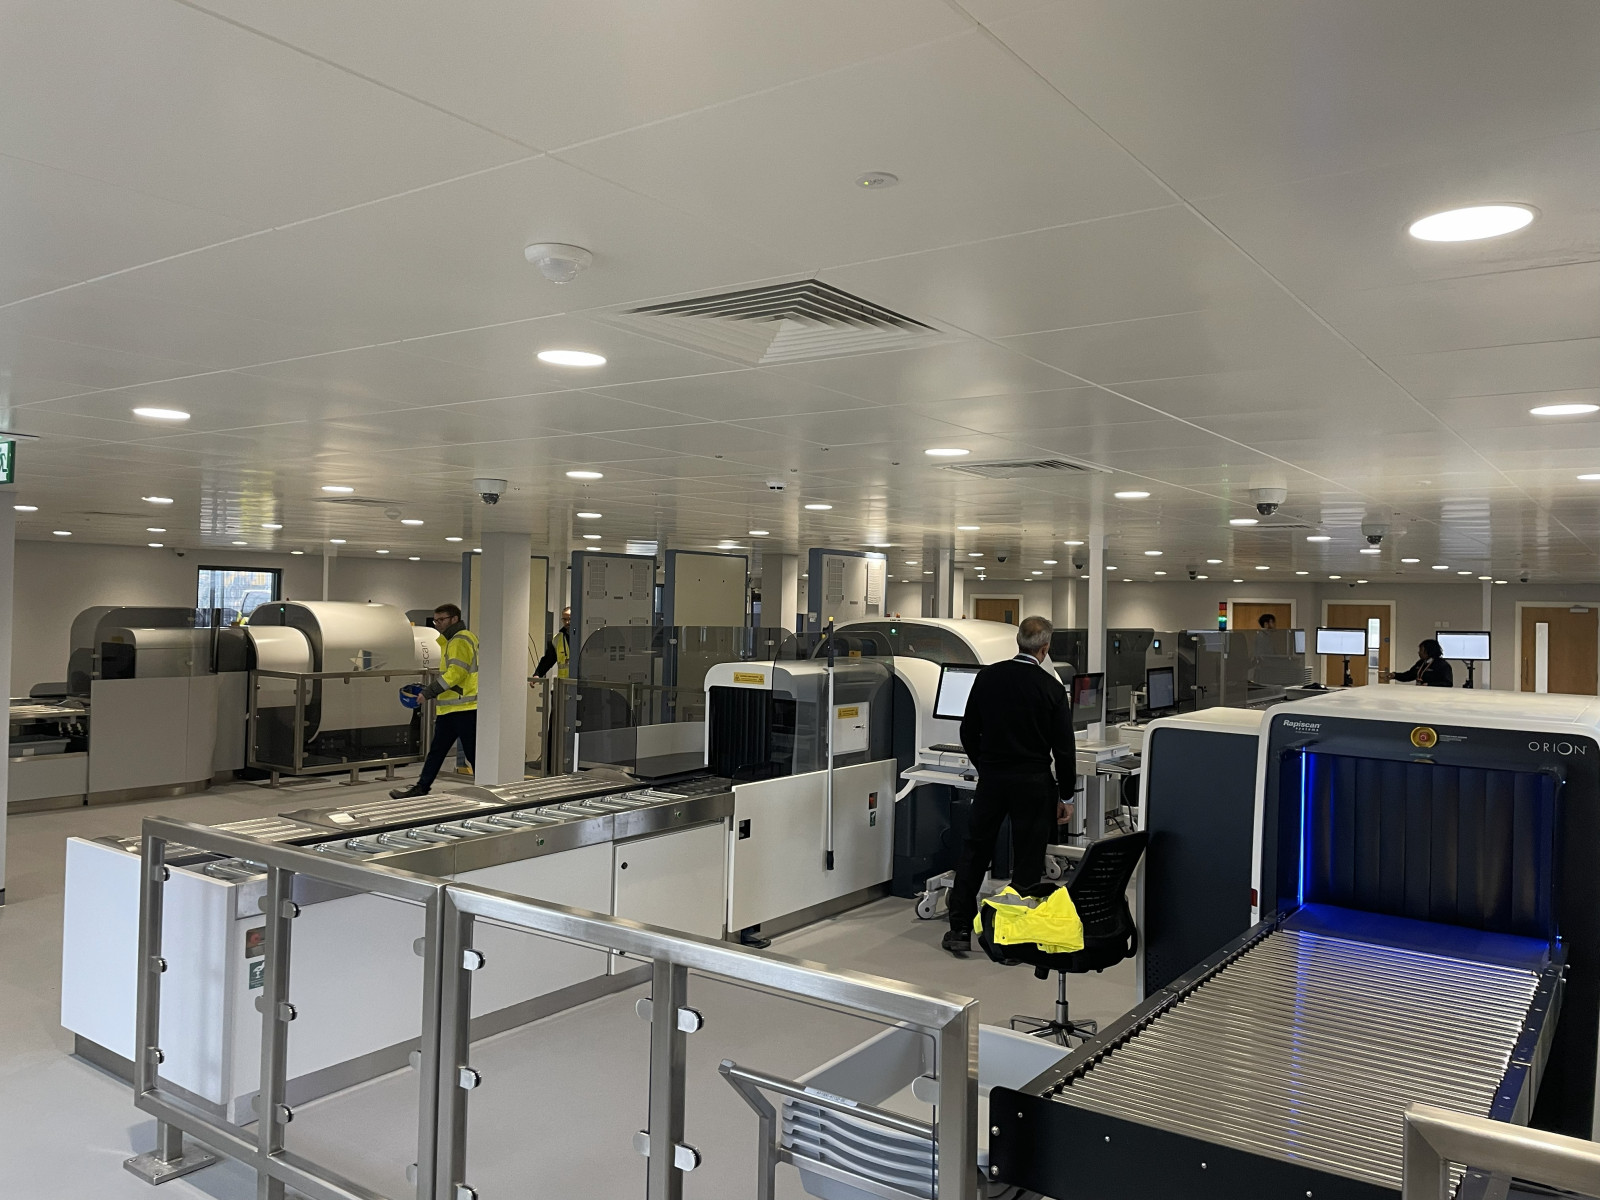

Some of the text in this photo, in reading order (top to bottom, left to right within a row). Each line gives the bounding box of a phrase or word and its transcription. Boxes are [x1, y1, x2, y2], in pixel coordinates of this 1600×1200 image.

[420, 641, 430, 668] rscan
[1283, 719, 1320, 728] Rapiscan
[1528, 741, 1585, 756] ORION
